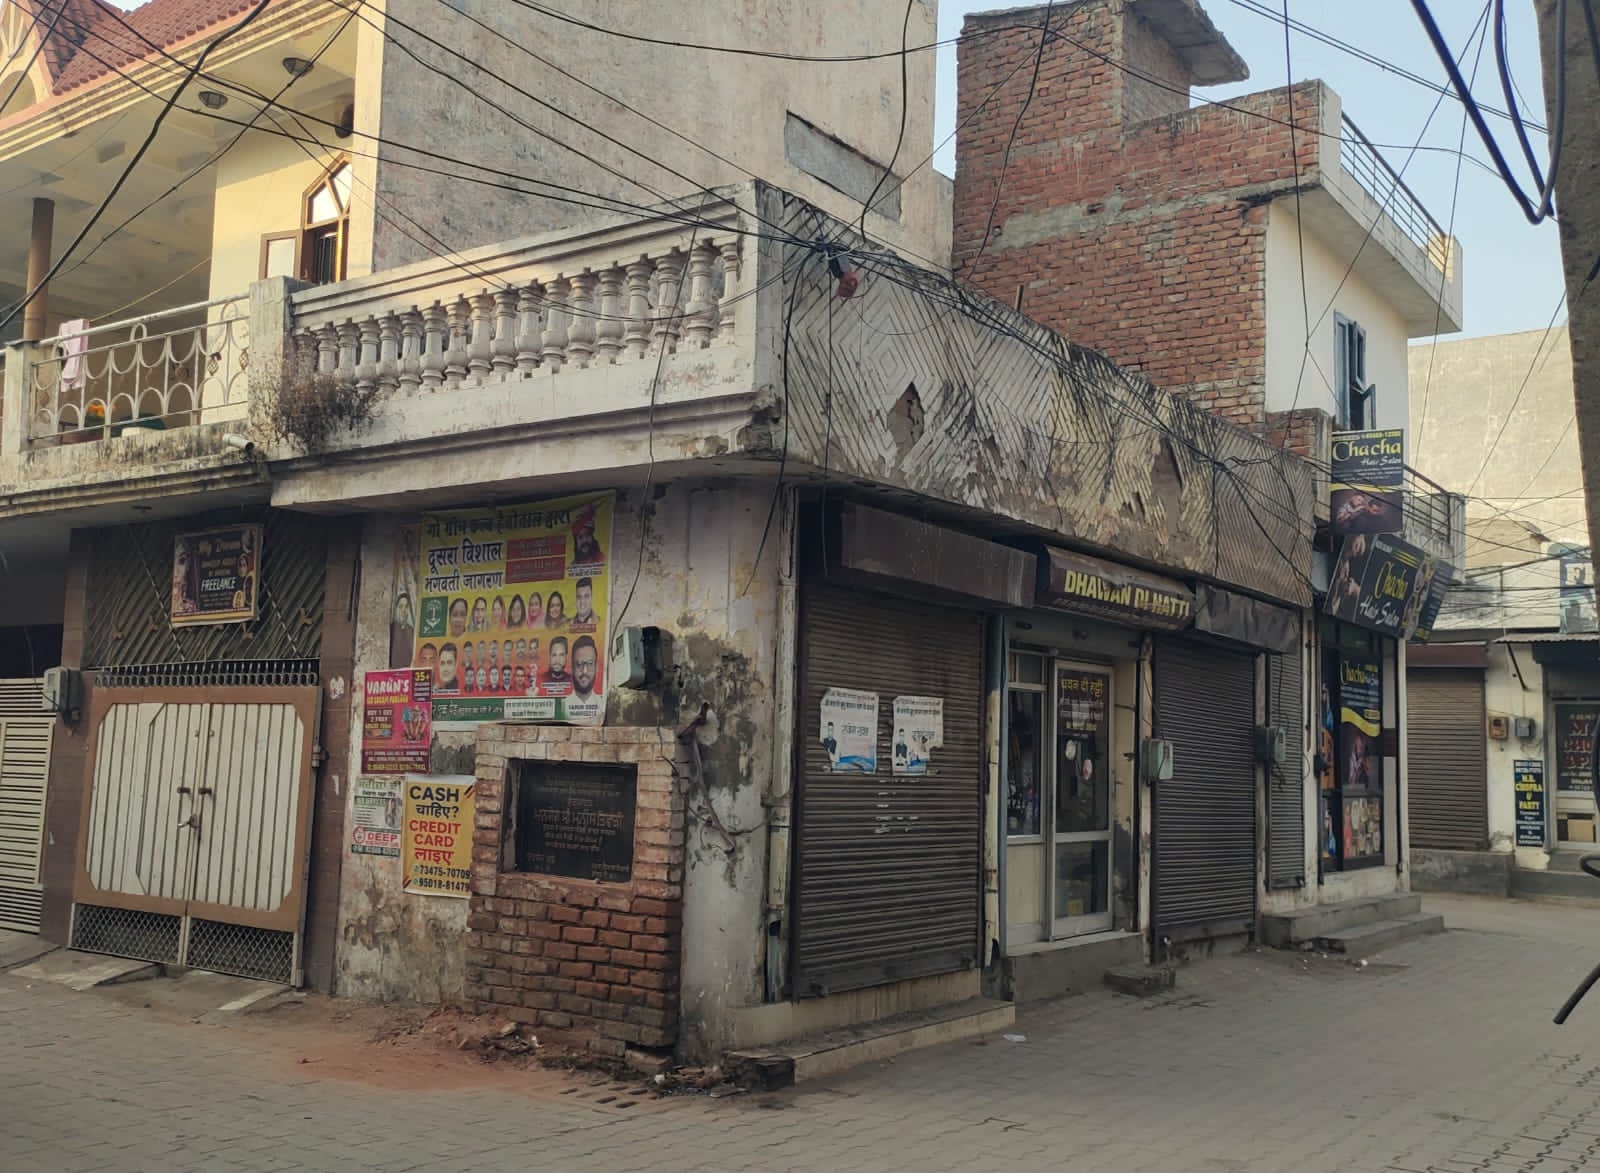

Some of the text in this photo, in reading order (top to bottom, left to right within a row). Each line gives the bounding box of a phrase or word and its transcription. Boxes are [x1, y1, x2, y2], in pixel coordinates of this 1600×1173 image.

[1333, 439, 1401, 462] Chacha
[428, 546, 458, 576] दूसरा
[462, 538, 504, 564] विशाल
[201, 577, 236, 592] FREELANCE
[425, 569, 503, 593] भगवती जागरण
[1374, 561, 1408, 600] Chacha
[410, 786, 459, 802] CASH
[416, 802, 459, 818] चाहिए?
[409, 820, 461, 834] CREDIT
[368, 832, 398, 843] DEEP
[414, 834, 455, 848] CARD
[414, 848, 455, 865] लाइए
